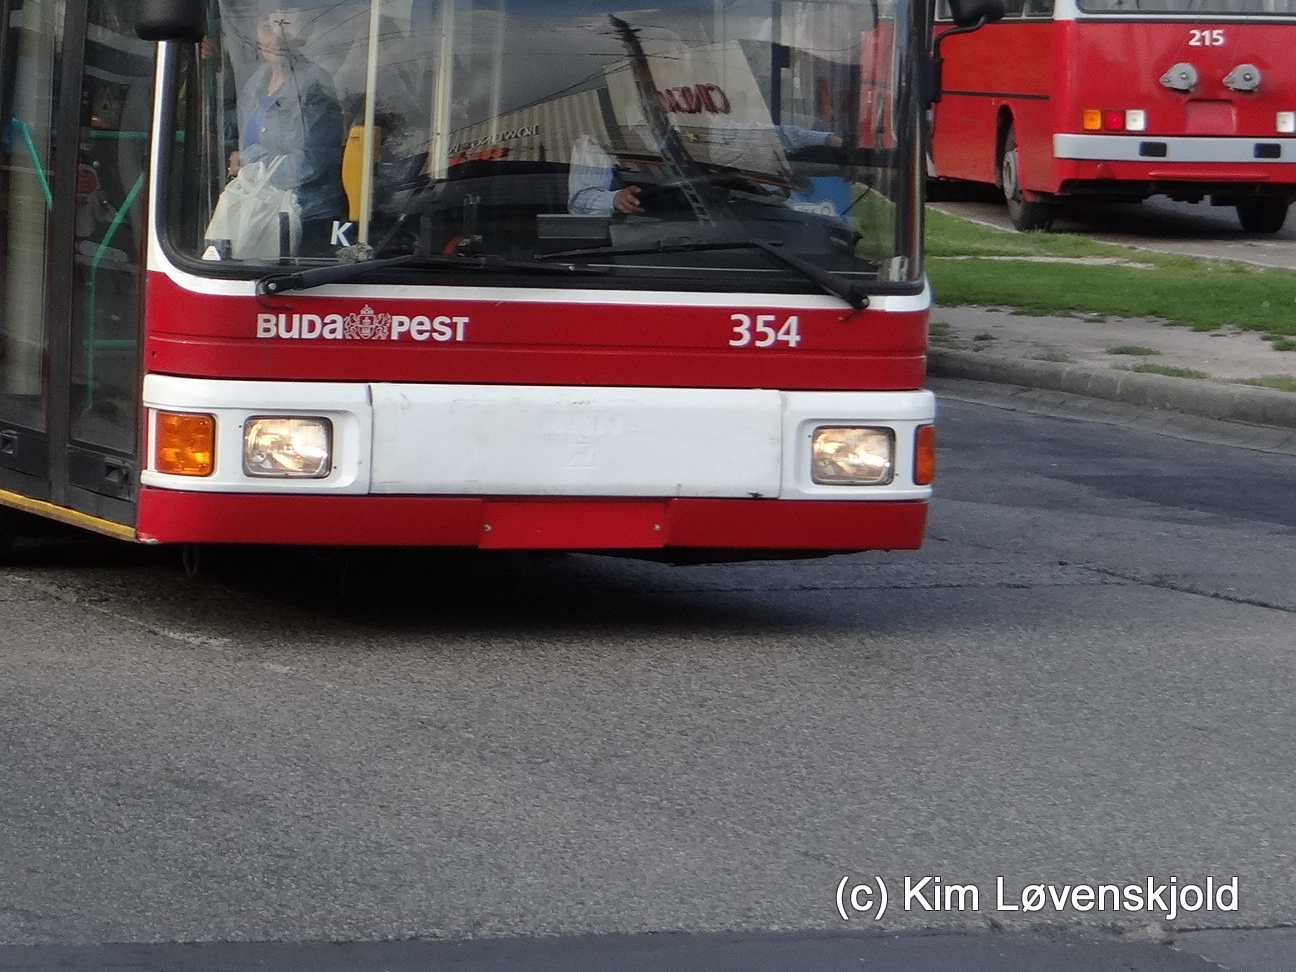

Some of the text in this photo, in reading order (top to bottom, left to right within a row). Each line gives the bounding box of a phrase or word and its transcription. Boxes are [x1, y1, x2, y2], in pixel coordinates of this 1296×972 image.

[1188, 29, 1225, 46] 215
[330, 220, 353, 247] K
[728, 313, 802, 348] 354
